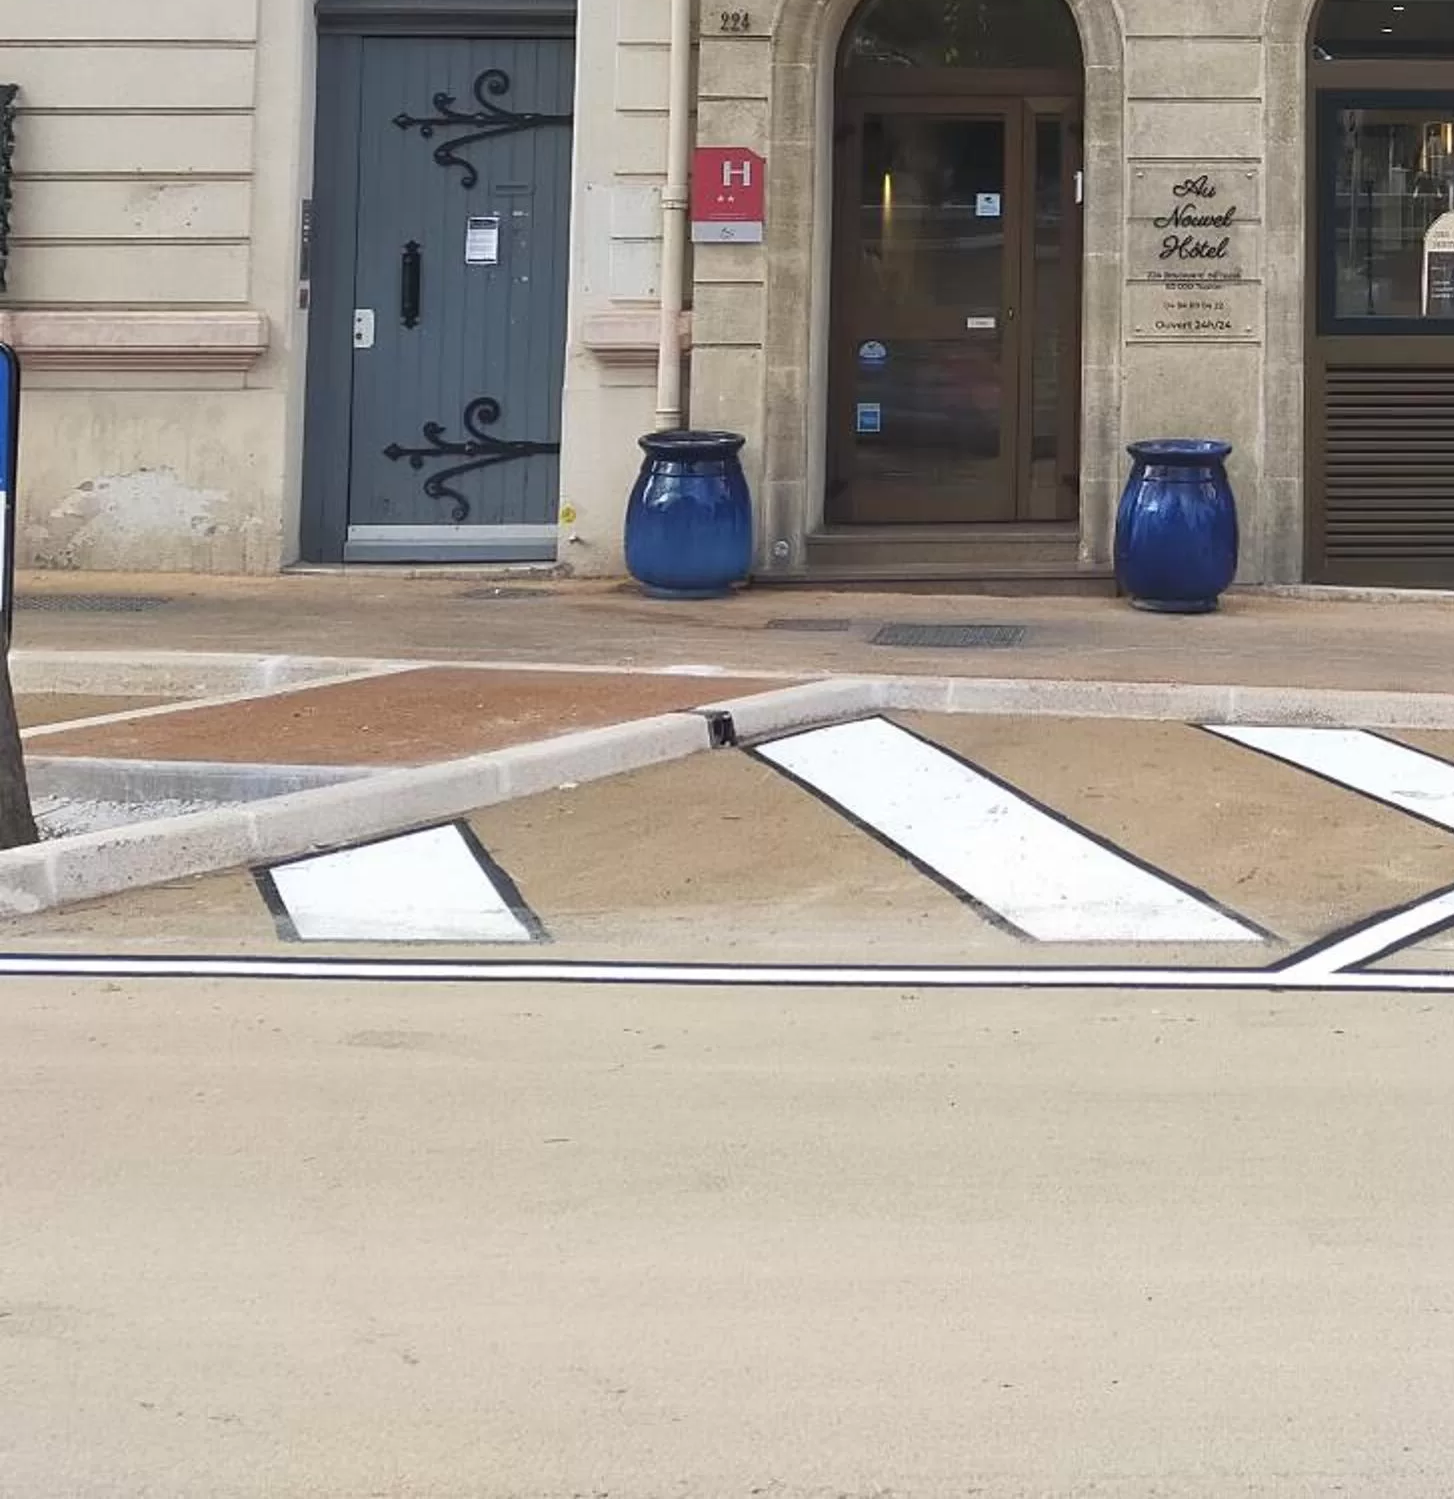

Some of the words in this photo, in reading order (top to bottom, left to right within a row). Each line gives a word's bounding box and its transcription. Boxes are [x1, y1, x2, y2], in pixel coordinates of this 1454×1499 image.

[723, 160, 751, 187] H
[1172, 174, 1216, 198] Au
[1152, 203, 1237, 229] Nouvel
[1158, 234, 1230, 260] Hôtel
